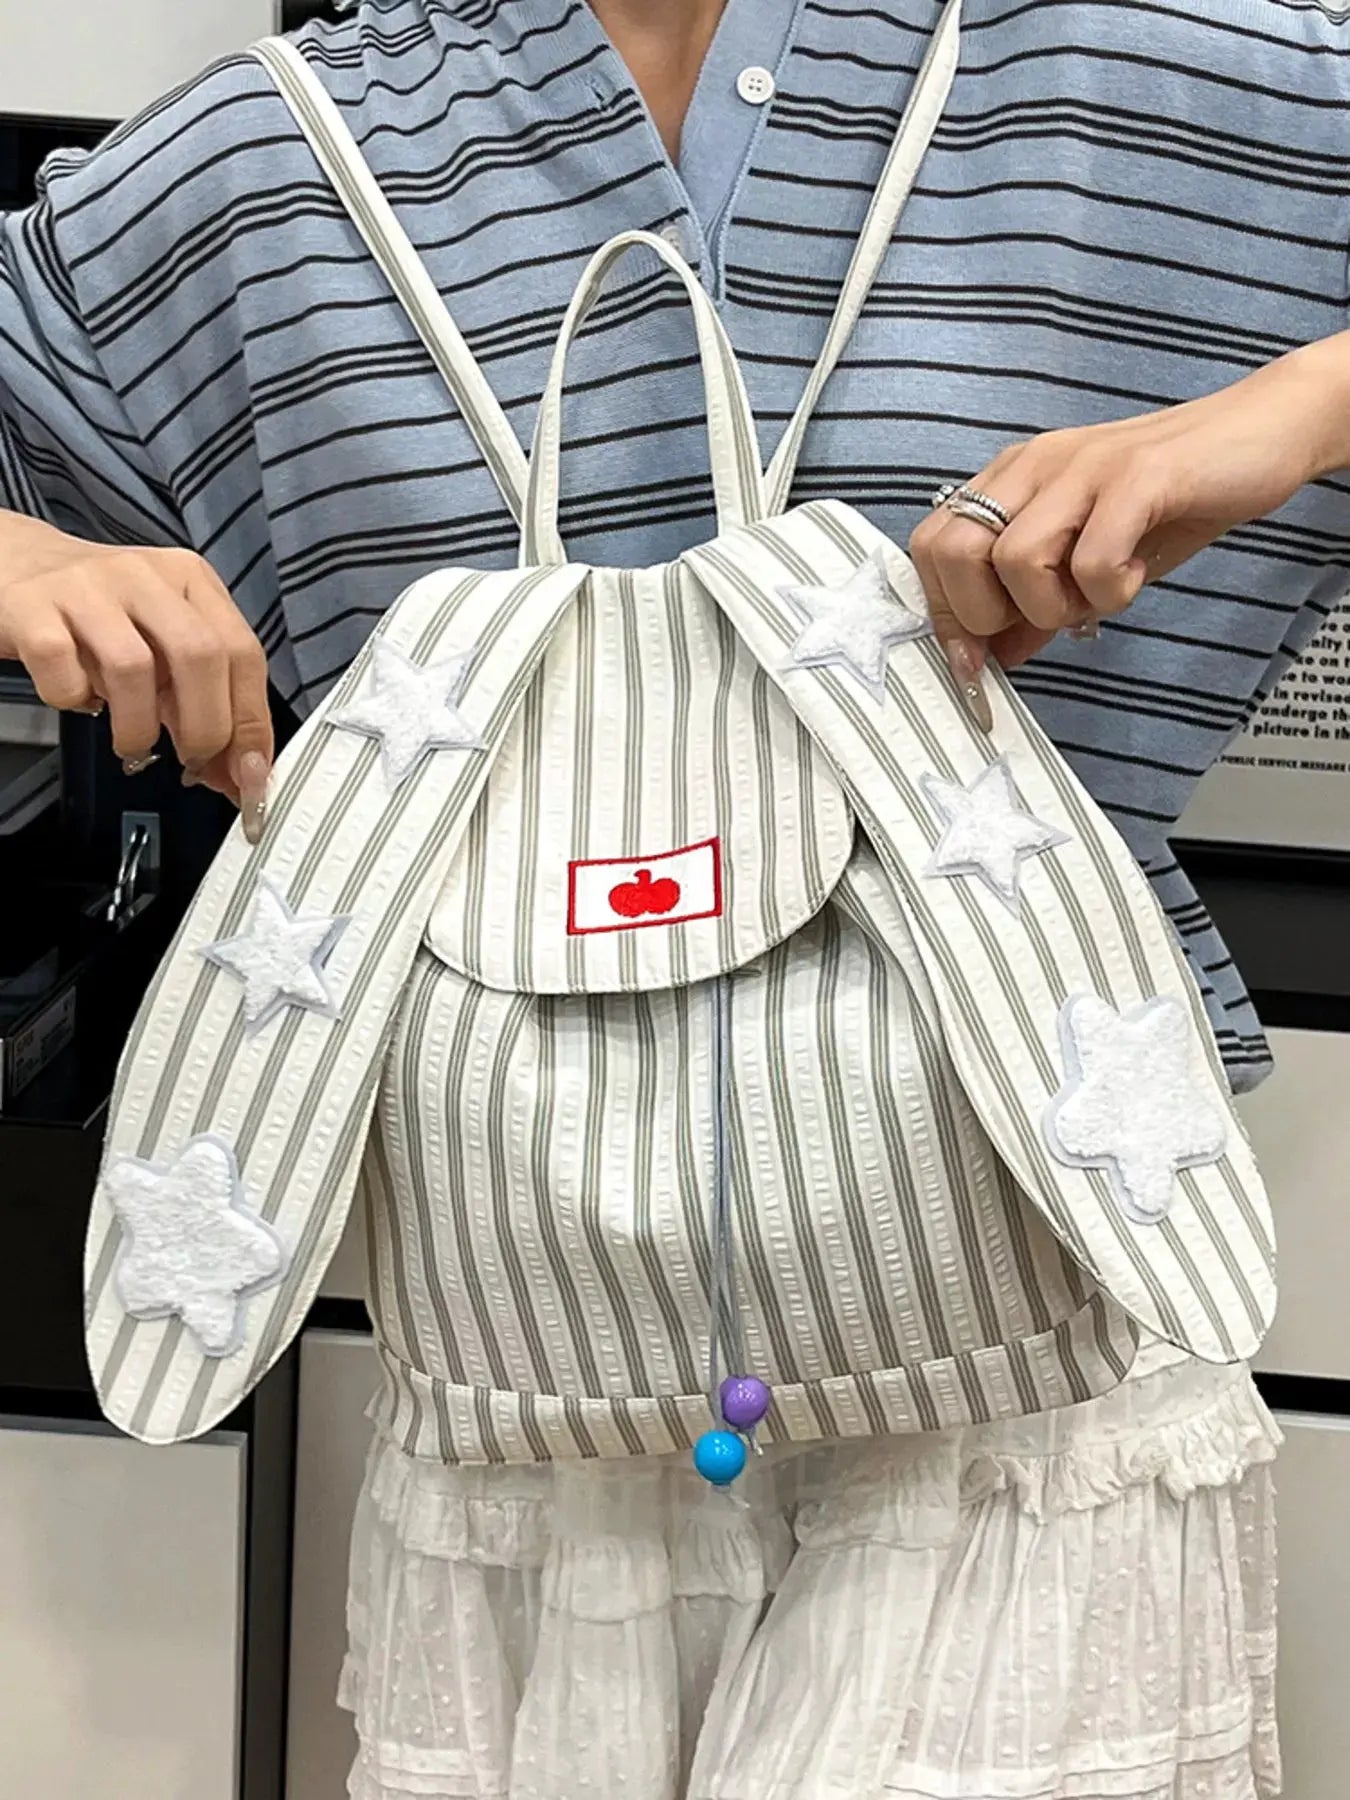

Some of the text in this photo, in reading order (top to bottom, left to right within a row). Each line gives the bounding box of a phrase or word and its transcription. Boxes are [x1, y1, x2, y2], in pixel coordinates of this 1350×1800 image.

[1319, 657, 1339, 668] on
[1302, 671, 1318, 683] to
[1273, 686, 1288, 700] in
[1260, 703, 1328, 722] undergo
[1252, 721, 1310, 738] picture
[1314, 724, 1330, 739] in
[1221, 755, 1256, 767] PUBLIC
[1258, 757, 1298, 769] SERVICE
[1299, 760, 1346, 772] MESSAGE
